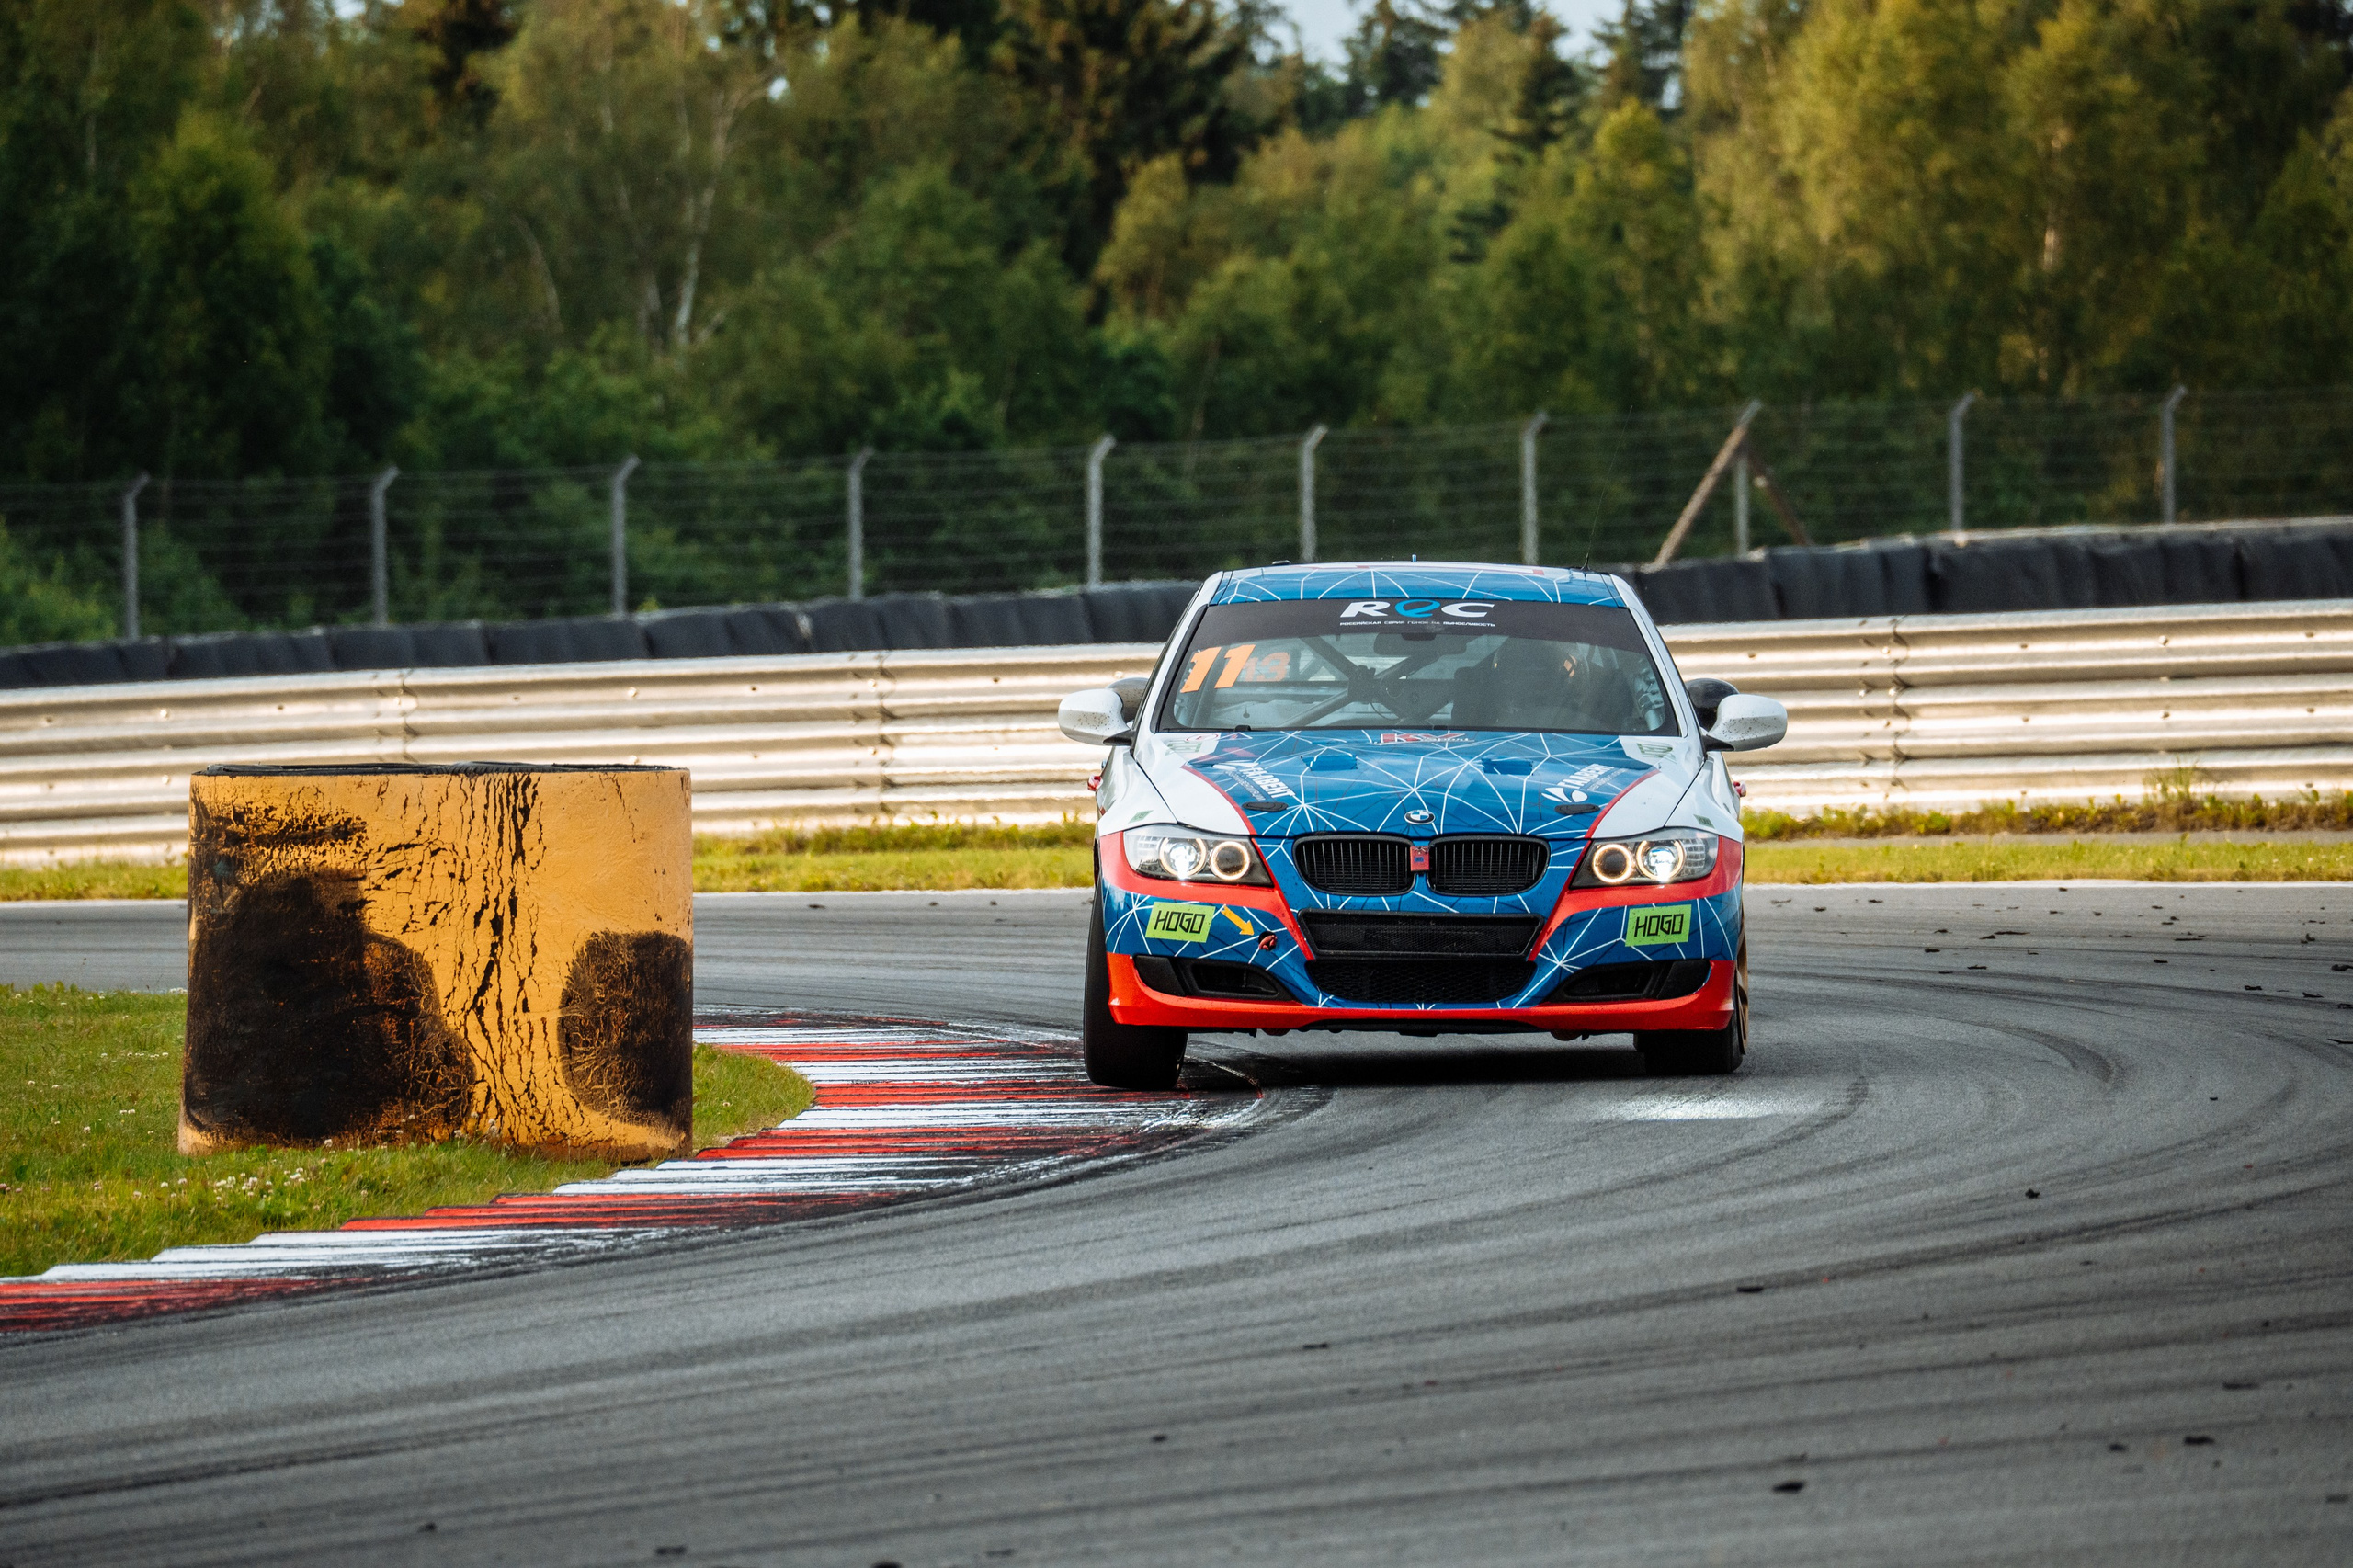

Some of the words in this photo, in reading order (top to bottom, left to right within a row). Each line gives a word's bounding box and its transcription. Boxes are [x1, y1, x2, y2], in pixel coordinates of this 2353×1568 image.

[1180, 644, 1256, 693] 11
[1154, 910, 1206, 934] HOGO
[1634, 914, 1684, 937] HOGO
